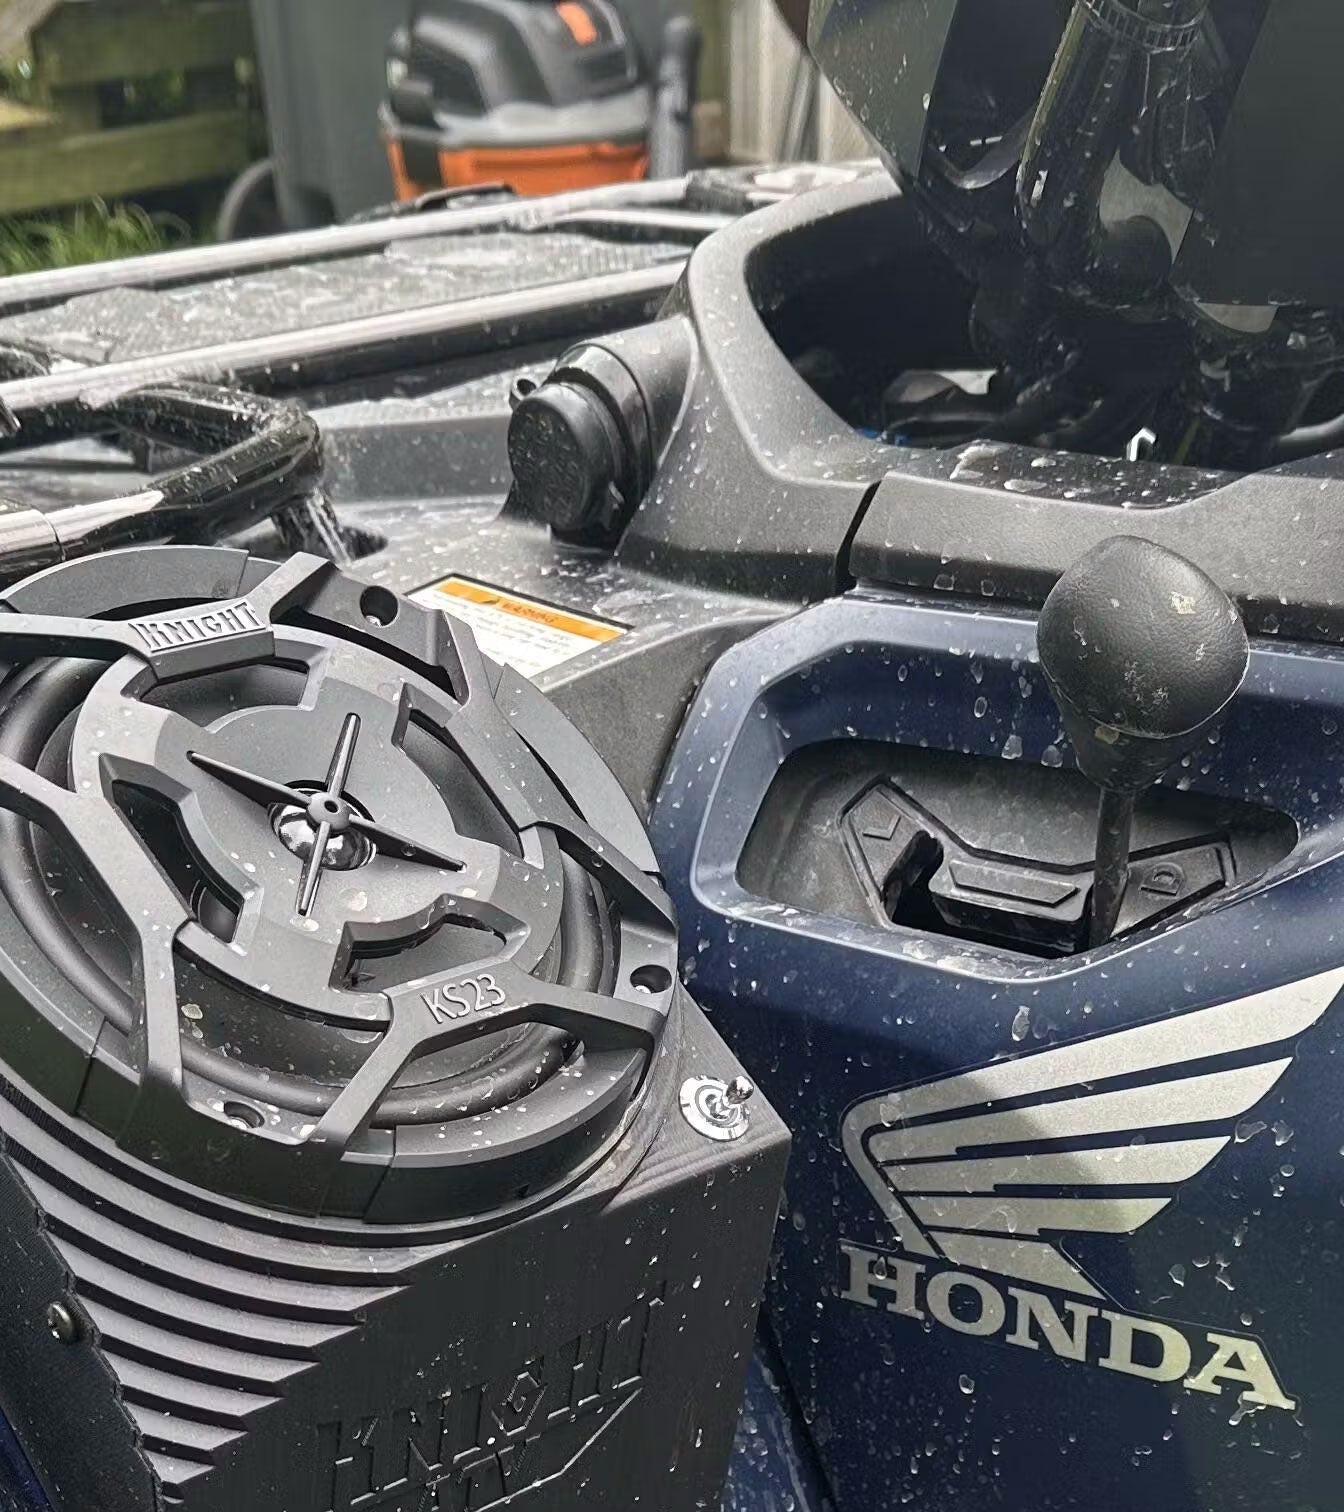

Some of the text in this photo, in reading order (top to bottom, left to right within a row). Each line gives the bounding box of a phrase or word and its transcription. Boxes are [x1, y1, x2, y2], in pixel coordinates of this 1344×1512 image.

[128, 601, 266, 651] KNIGHT
[419, 973, 506, 1024] KS23
[839, 1244, 1296, 1411] HONDA
